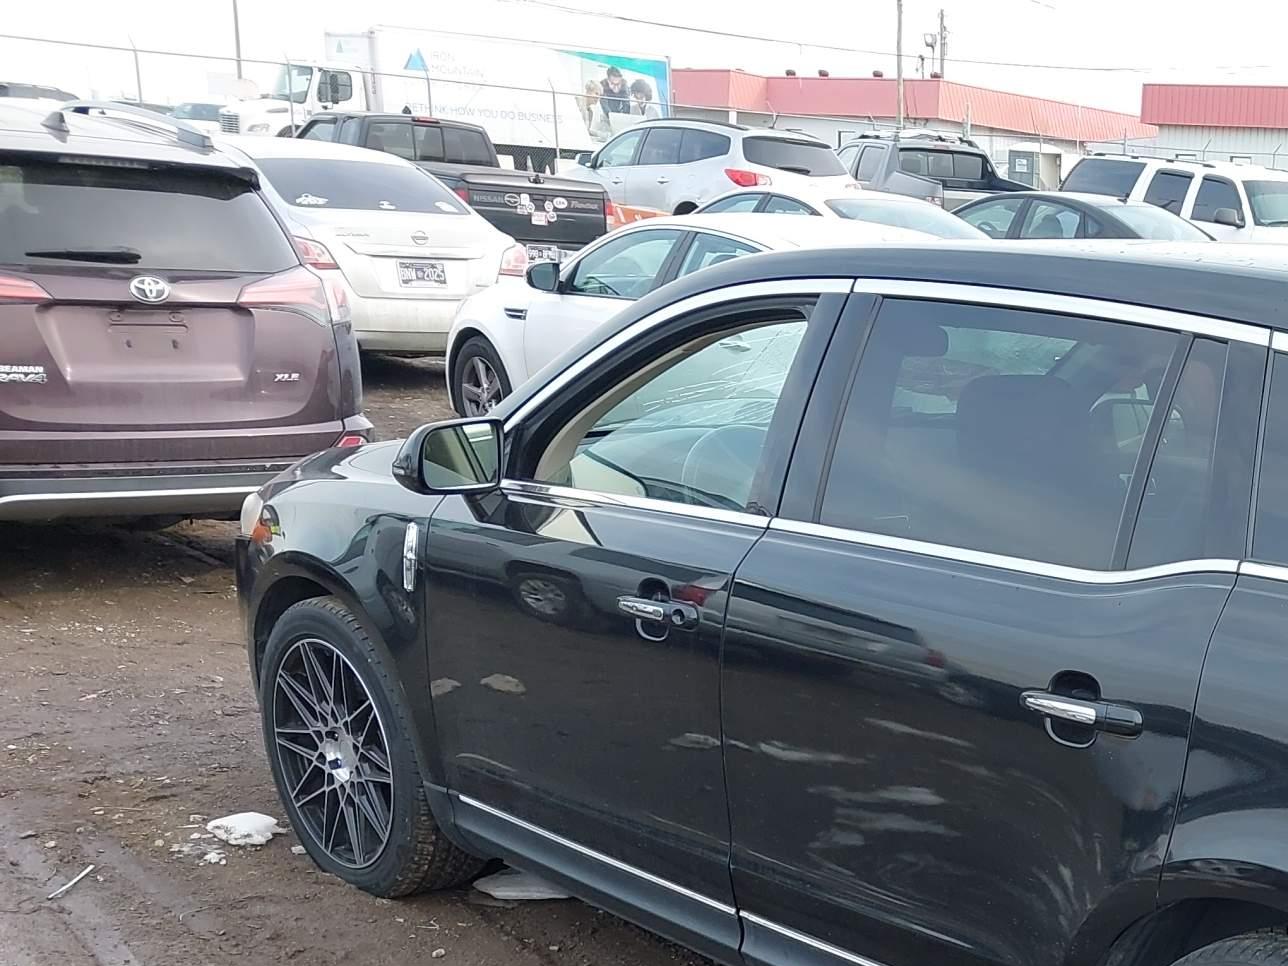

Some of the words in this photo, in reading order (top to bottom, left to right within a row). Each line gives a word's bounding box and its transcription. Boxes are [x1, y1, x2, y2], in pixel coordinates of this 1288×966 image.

[450, 104, 475, 116] HOW
[477, 107, 498, 119] YOU
[500, 110, 516, 121] DO
[274, 373, 300, 382] XLE
